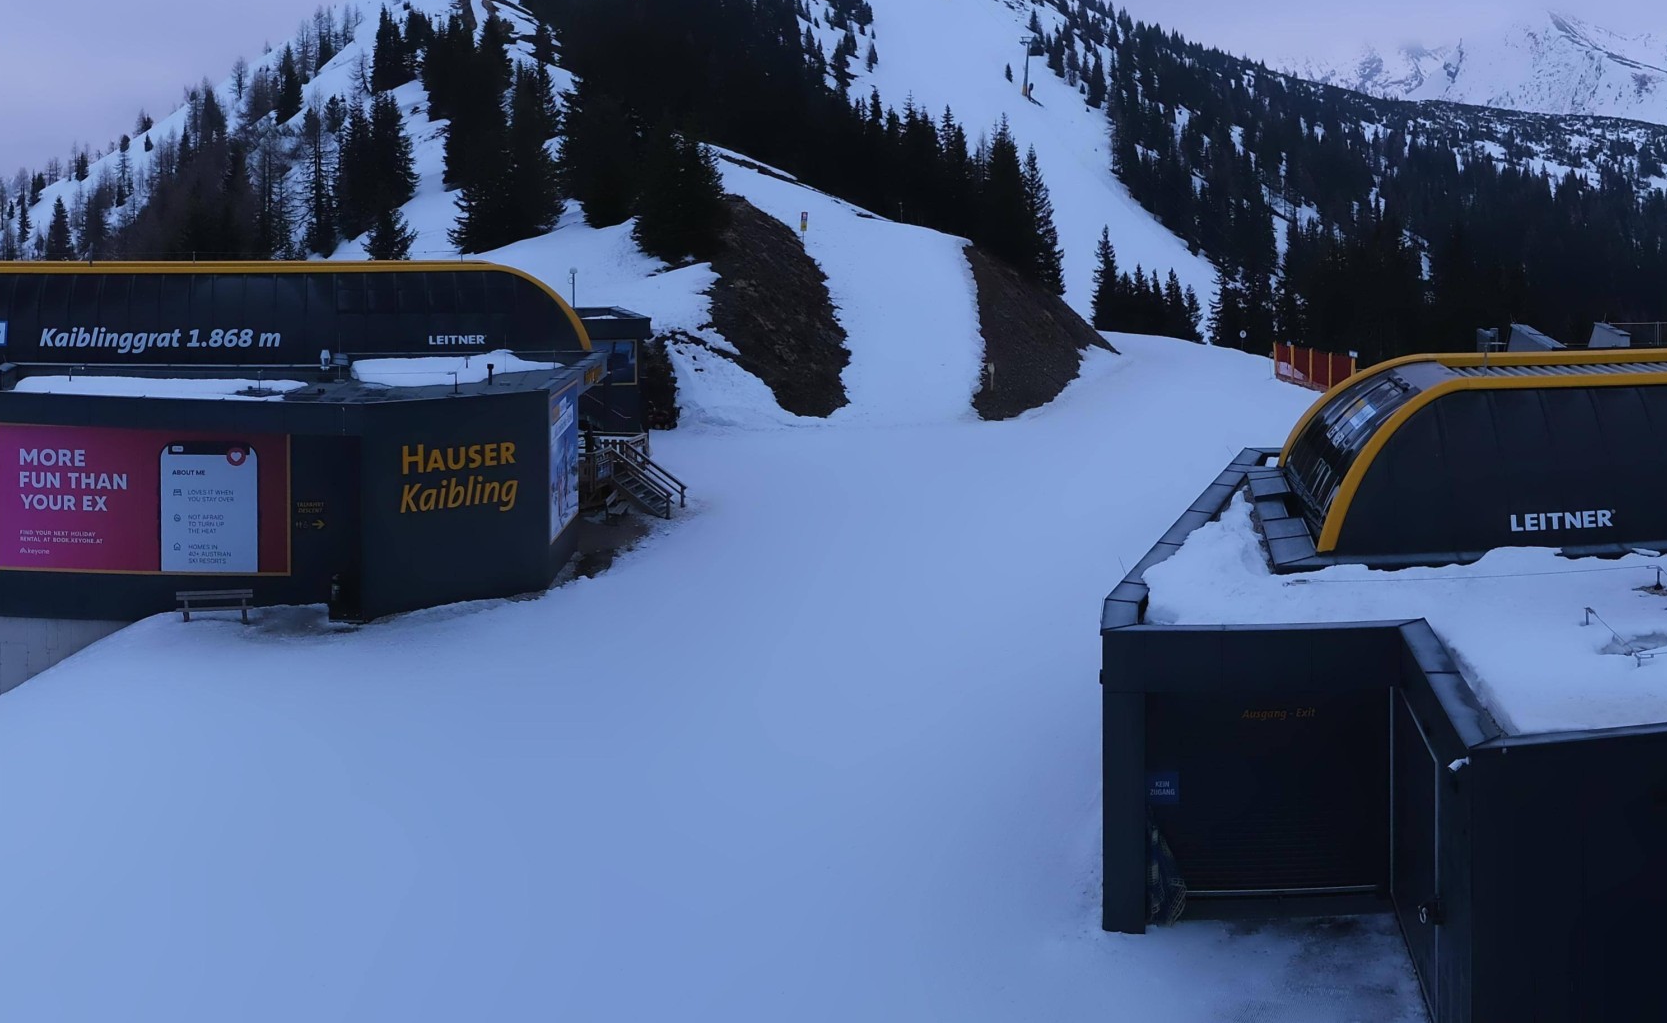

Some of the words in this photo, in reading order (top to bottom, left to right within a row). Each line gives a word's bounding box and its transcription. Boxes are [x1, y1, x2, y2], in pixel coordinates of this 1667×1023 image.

[40, 327, 181, 354] Kaiblinggrat
[186, 328, 253, 348] 1.868
[259, 332, 281, 347] m
[428, 334, 485, 345] LEITNER
[20, 448, 86, 466] MORE
[402, 441, 516, 475] HAUSER
[20, 471, 60, 489] FUN
[67, 473, 127, 490] THAN
[20, 494, 76, 511] YOUR
[82, 495, 108, 511] EX
[400, 475, 518, 514] Kaibling
[1510, 509, 1614, 532] LEITNER
[1241, 709, 1287, 721] Ausgang
[1296, 707, 1316, 717] Exit
